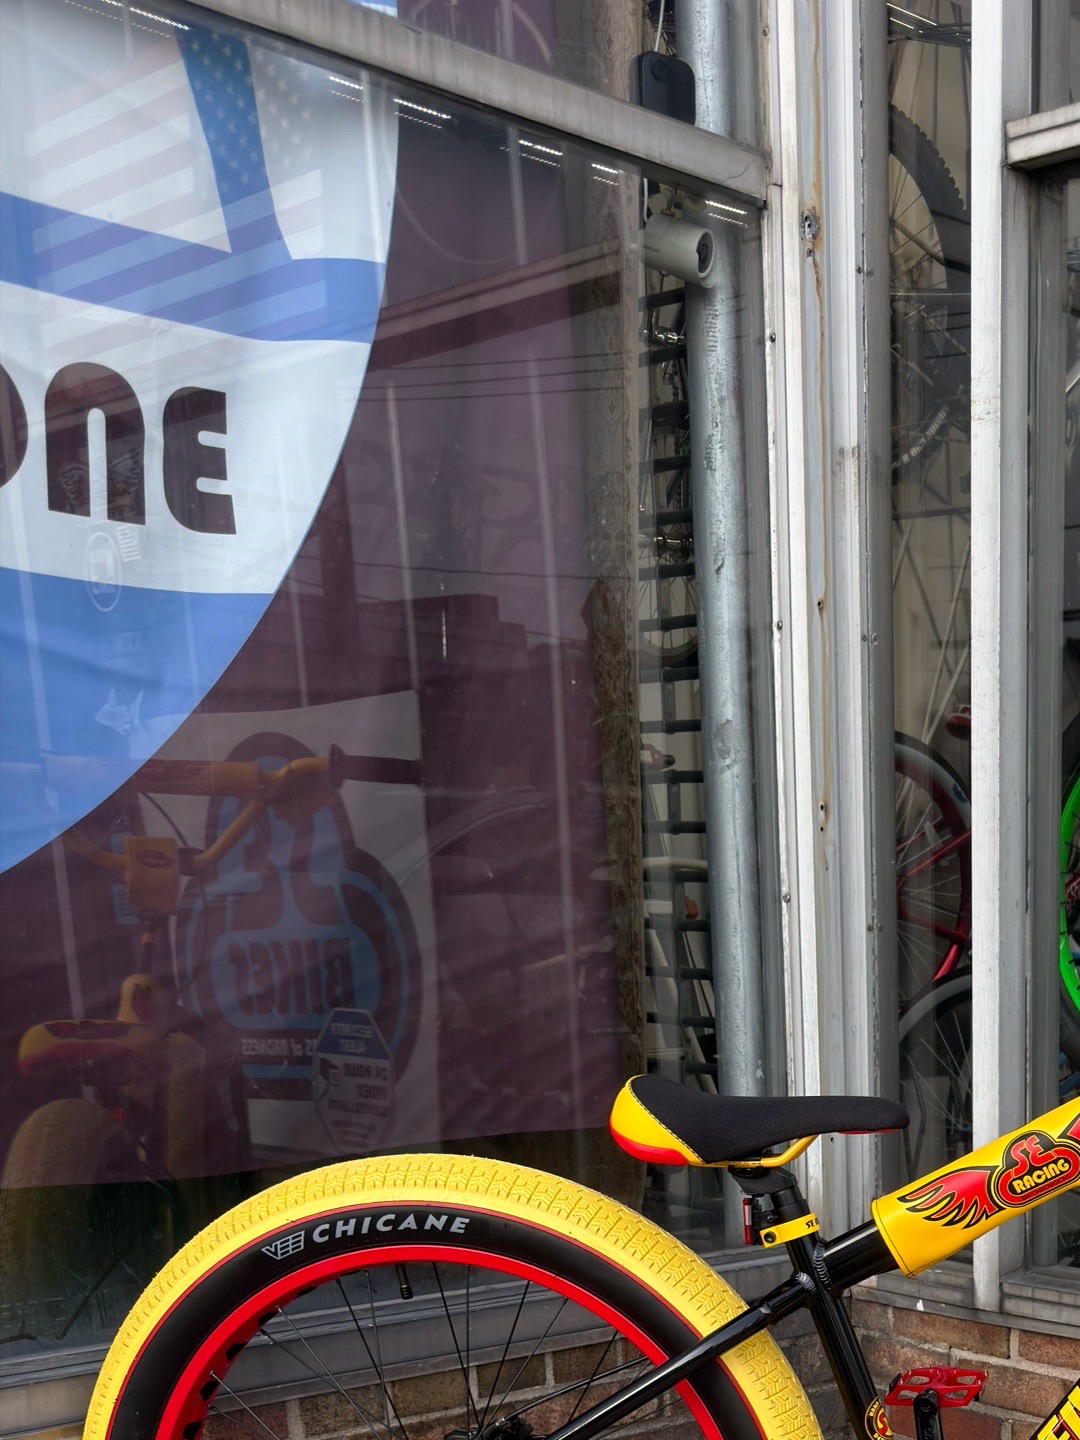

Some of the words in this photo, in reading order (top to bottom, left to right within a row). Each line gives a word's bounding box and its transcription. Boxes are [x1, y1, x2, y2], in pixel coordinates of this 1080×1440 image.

[0, 362, 237, 535] NE
[1010, 1134, 1058, 1178] SE
[1012, 1158, 1070, 1194] RACING
[311, 1213, 471, 1243] CHICANE
